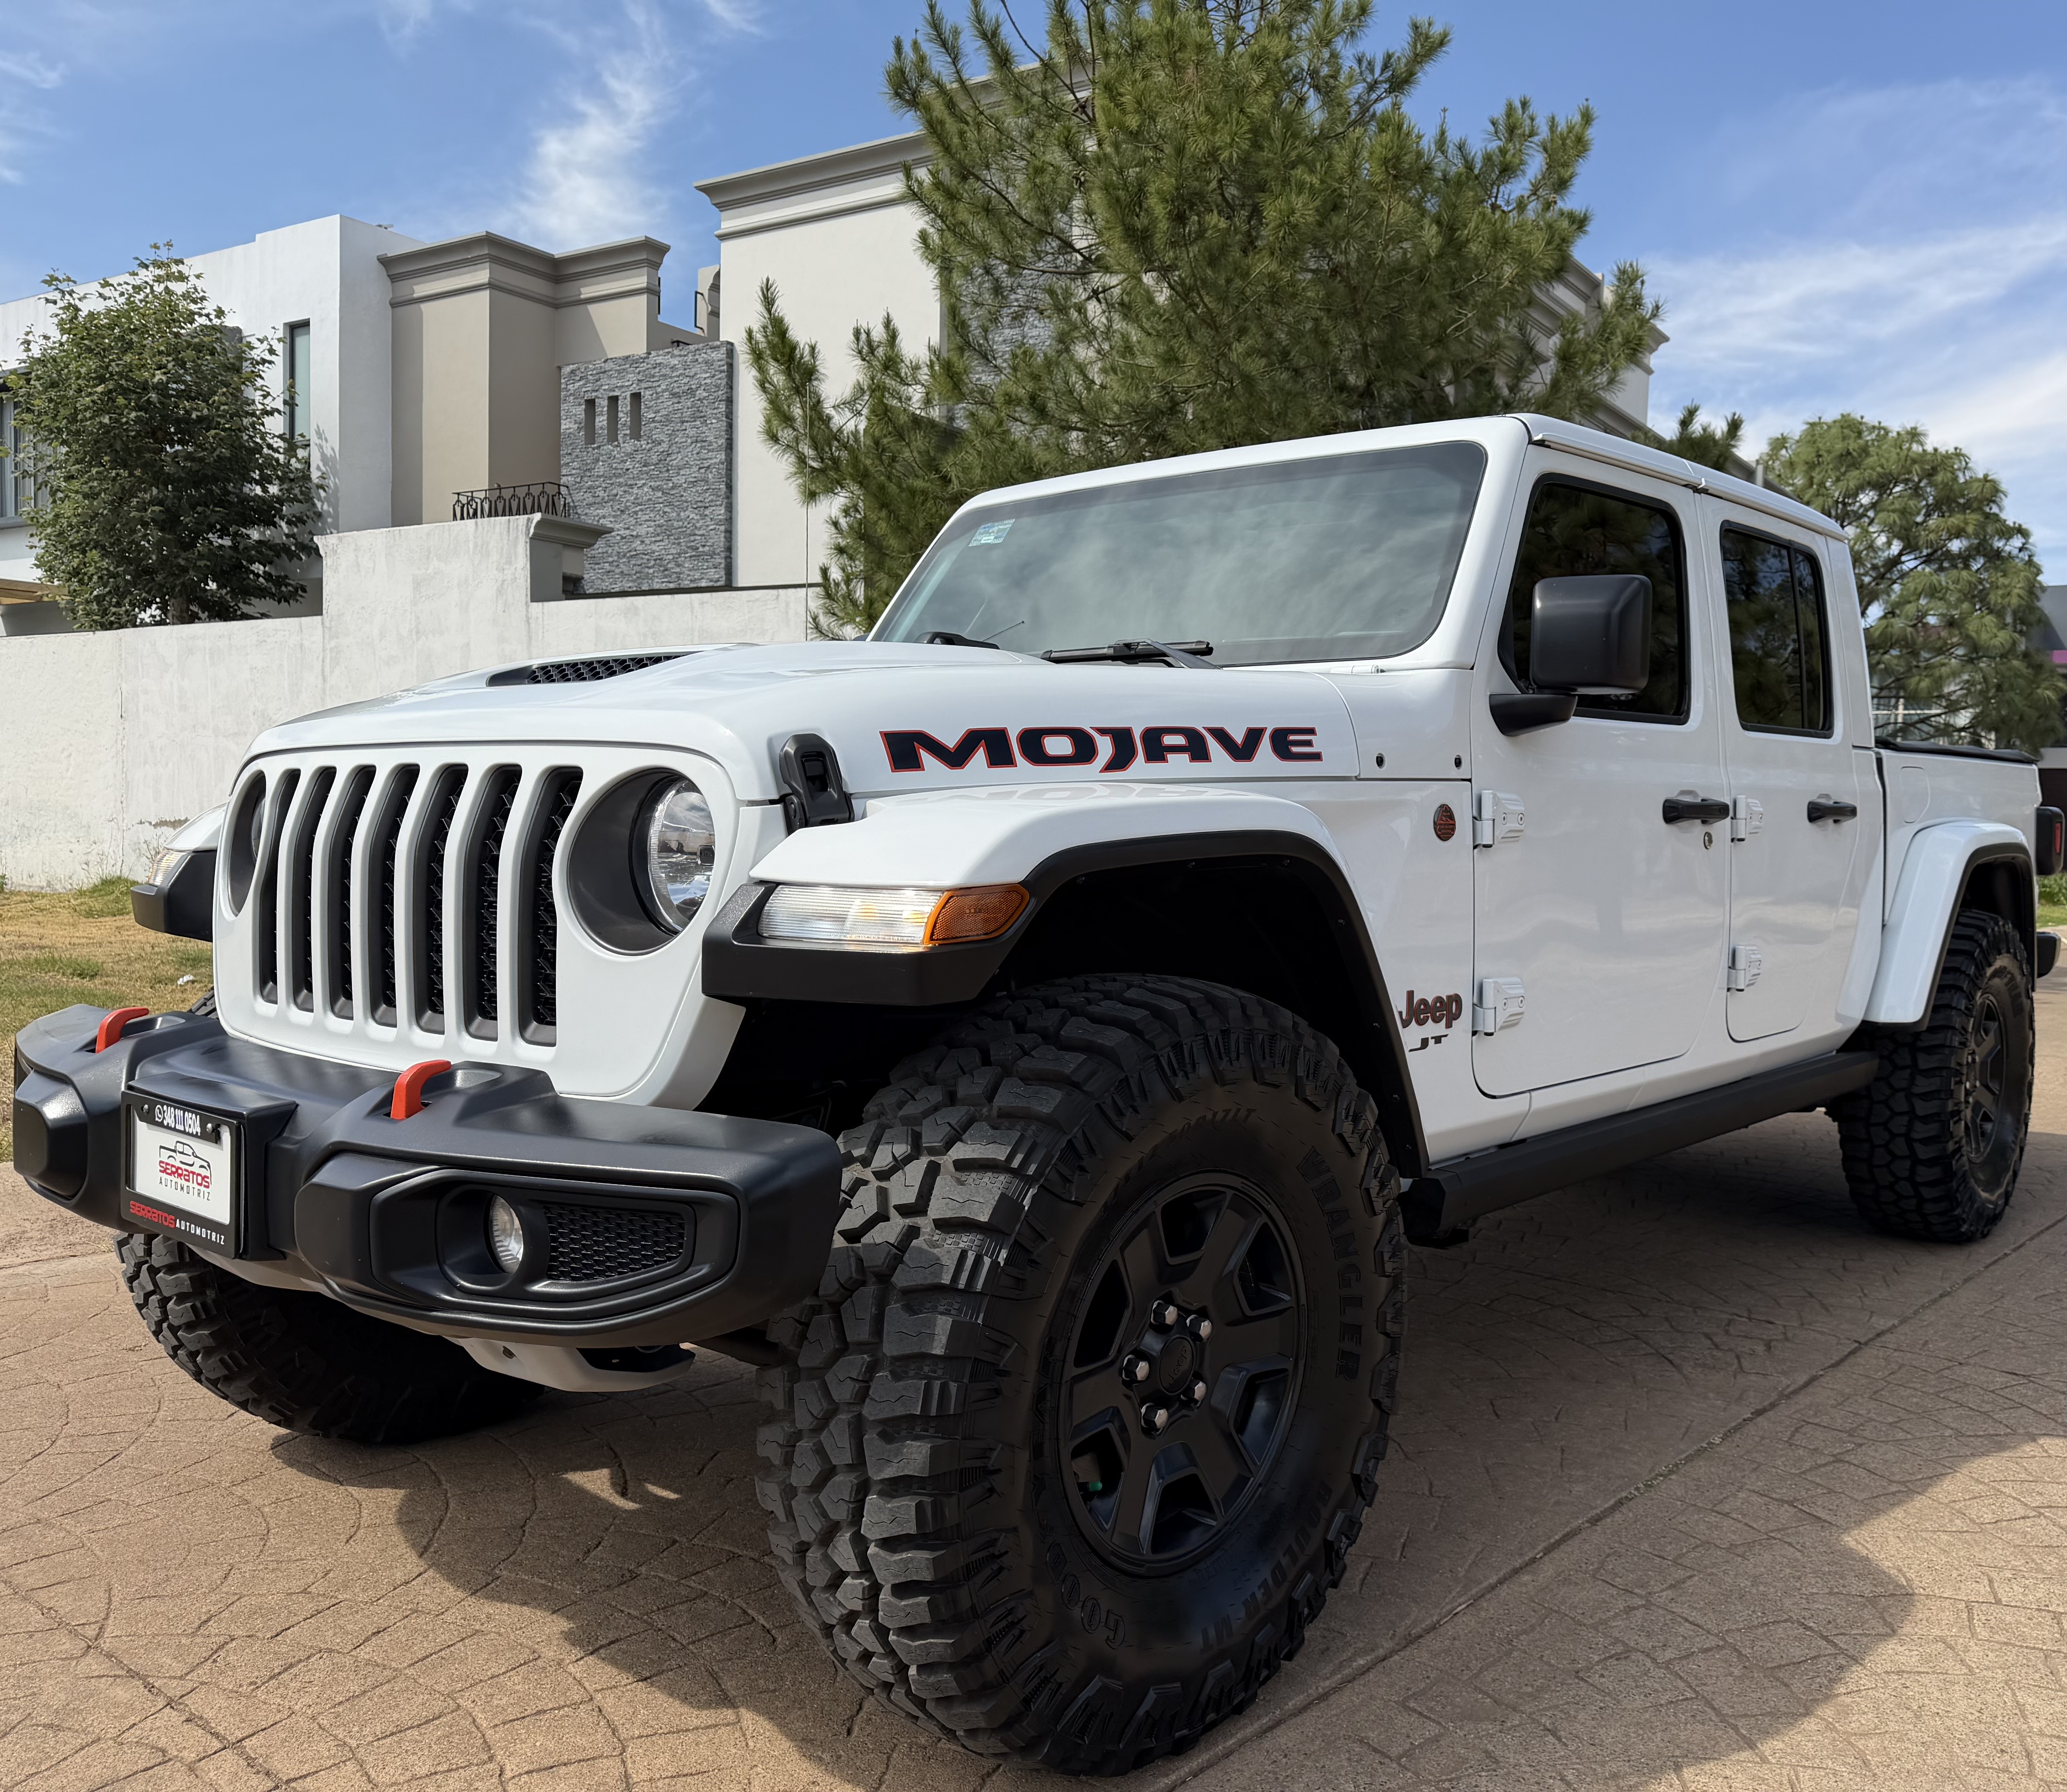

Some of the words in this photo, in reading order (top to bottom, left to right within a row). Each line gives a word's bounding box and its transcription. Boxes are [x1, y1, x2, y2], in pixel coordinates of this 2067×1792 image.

[879, 726, 1323, 773] MOJAVE
[1398, 989, 1463, 1029] Jeep
[1408, 1033, 1449, 1053] JT
[163, 1105, 175, 1128] 348
[175, 1108, 184, 1131] 111
[184, 1111, 201, 1136] 0504
[159, 1176, 211, 1201] AUTOMOTRIZ
[175, 1218, 225, 1245] AUTOMOTRIZ
[1297, 1146, 1364, 1382] WRANGLER
[1241, 1479, 1333, 1622] BOULDER
[1200, 1614, 1234, 1655] MT
